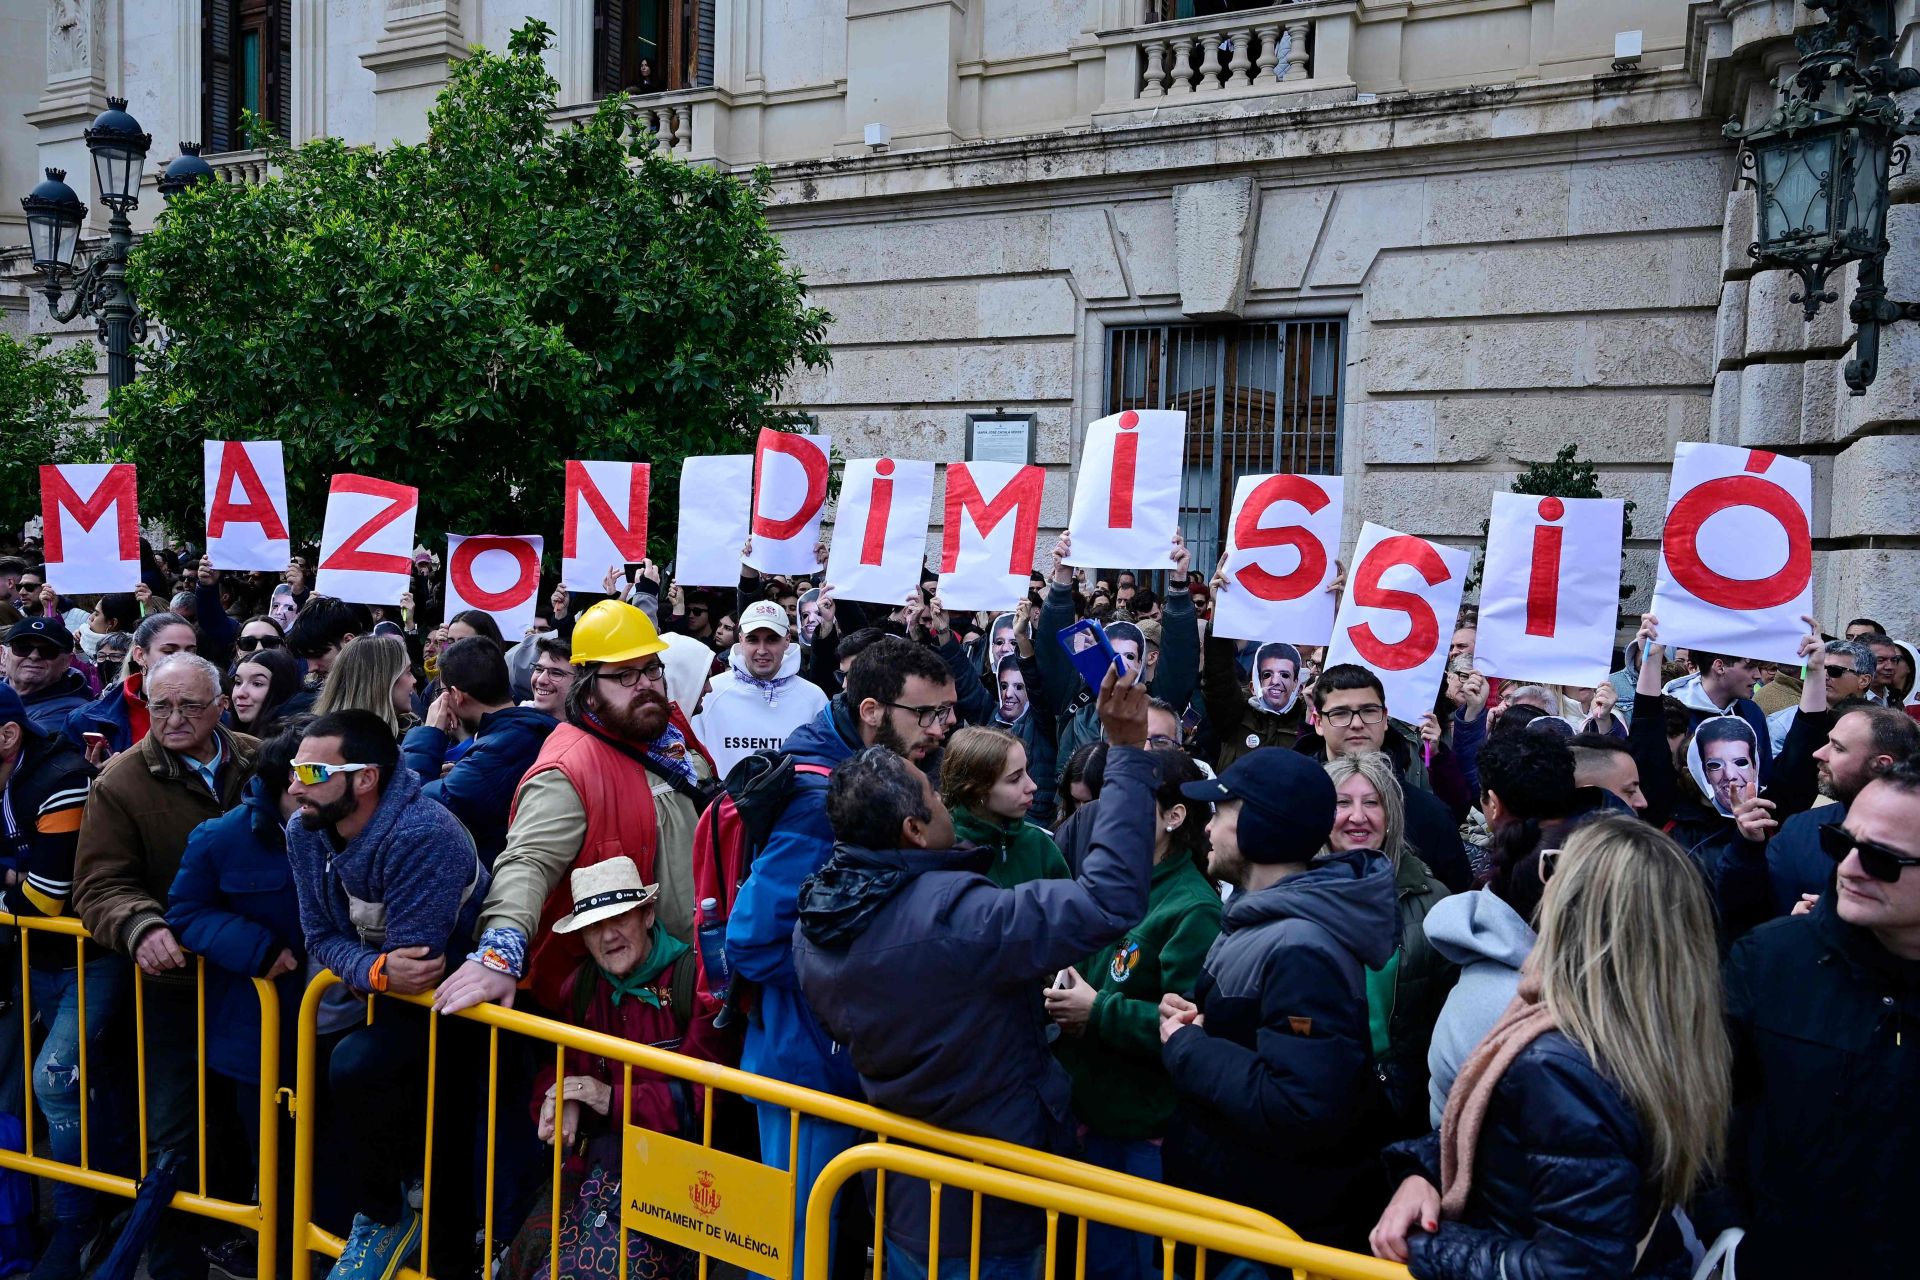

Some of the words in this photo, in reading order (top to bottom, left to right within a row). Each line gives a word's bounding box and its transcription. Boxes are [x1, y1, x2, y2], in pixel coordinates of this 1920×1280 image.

[630, 1199, 704, 1233] AJUNTAMENT
[705, 1223, 721, 1239] DE
[724, 1229, 779, 1260] VALÈNCIA
